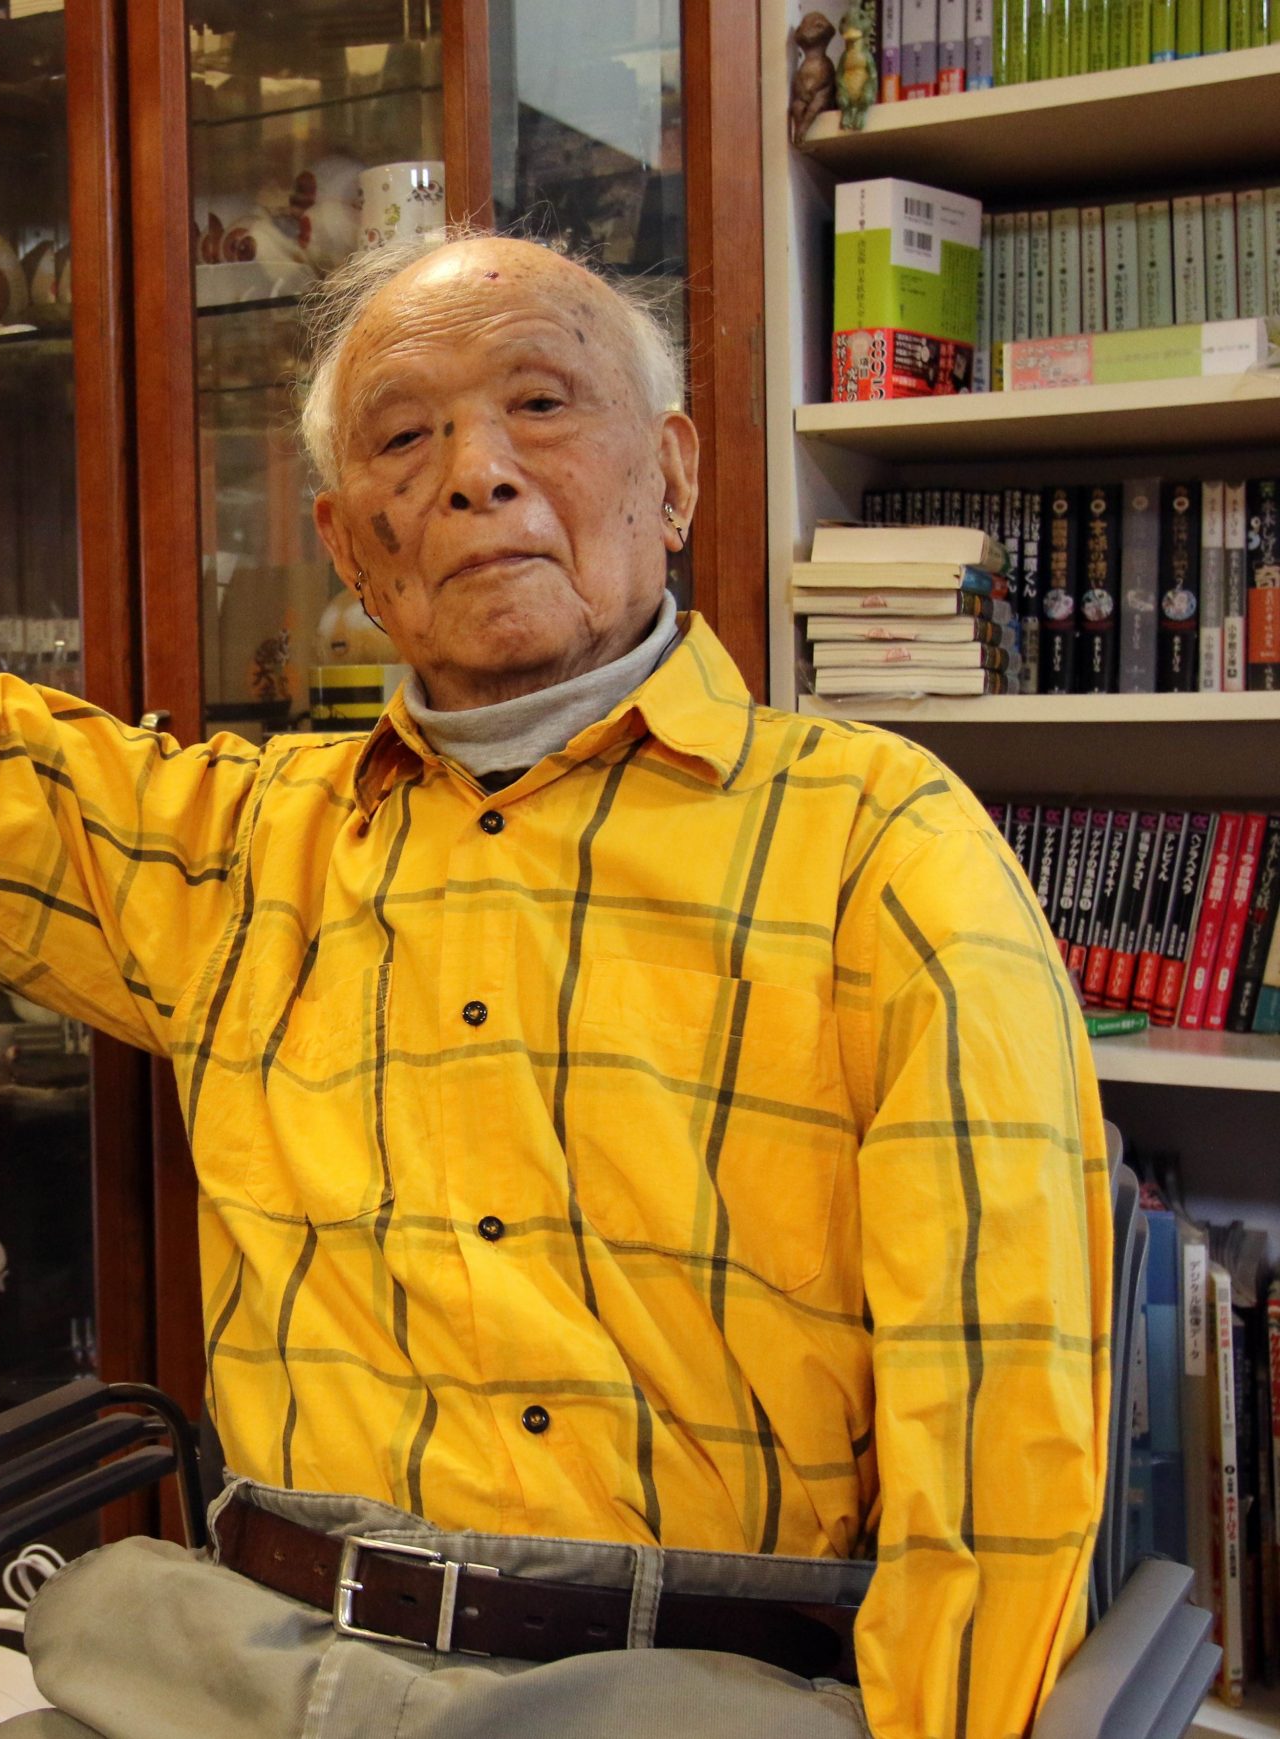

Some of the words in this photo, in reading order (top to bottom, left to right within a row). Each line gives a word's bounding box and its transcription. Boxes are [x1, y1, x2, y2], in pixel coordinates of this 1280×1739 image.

[1188, 1260, 1202, 1361] デジタル画像データ
